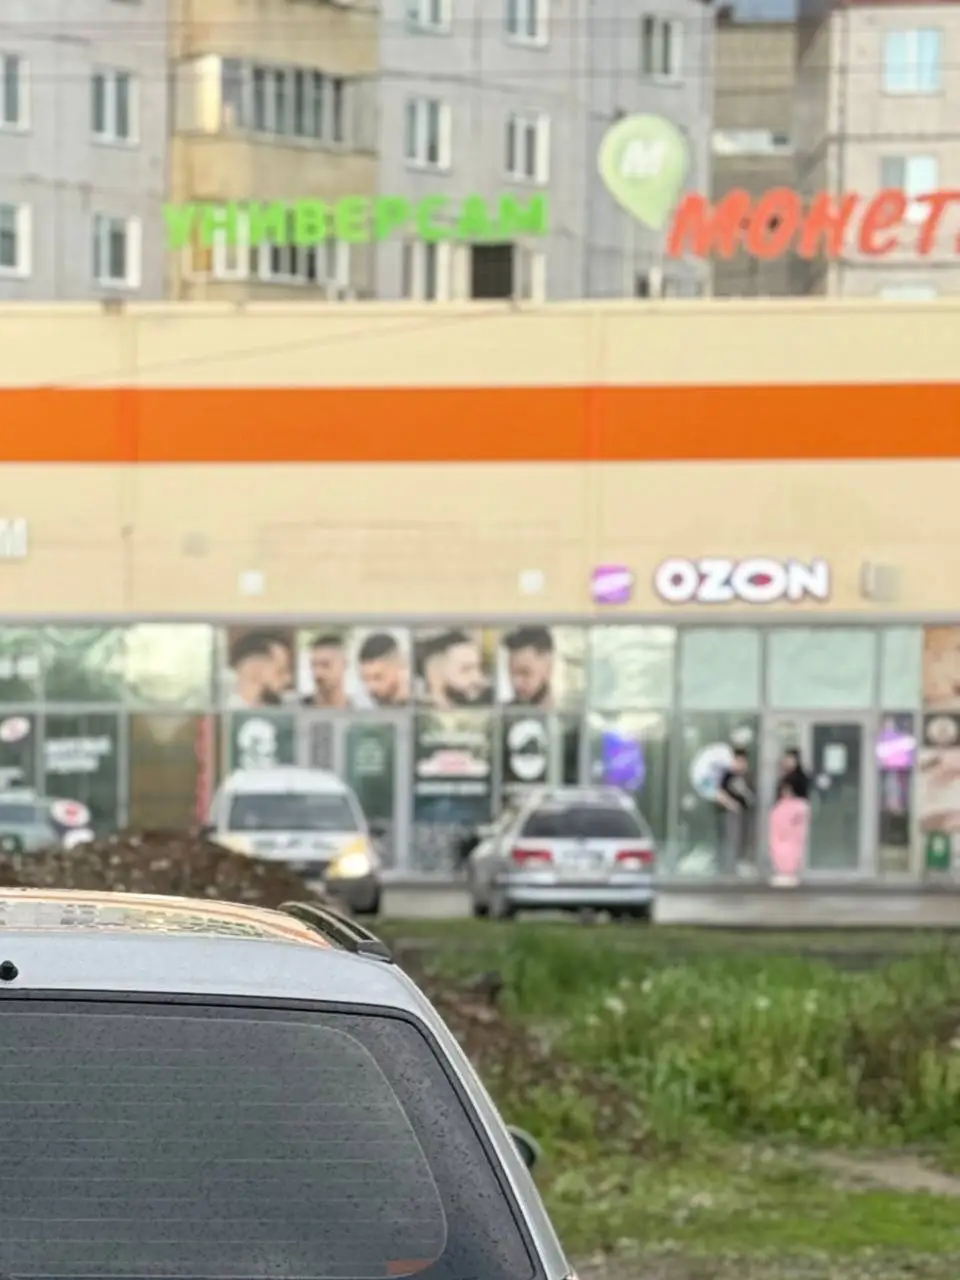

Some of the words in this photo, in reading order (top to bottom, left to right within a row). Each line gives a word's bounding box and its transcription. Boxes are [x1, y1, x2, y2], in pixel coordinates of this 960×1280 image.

[163, 194, 549, 249] УНИВЕРСАМ
[667, 189, 960, 260] МОНЕТ
[653, 557, 829, 603] OZON
